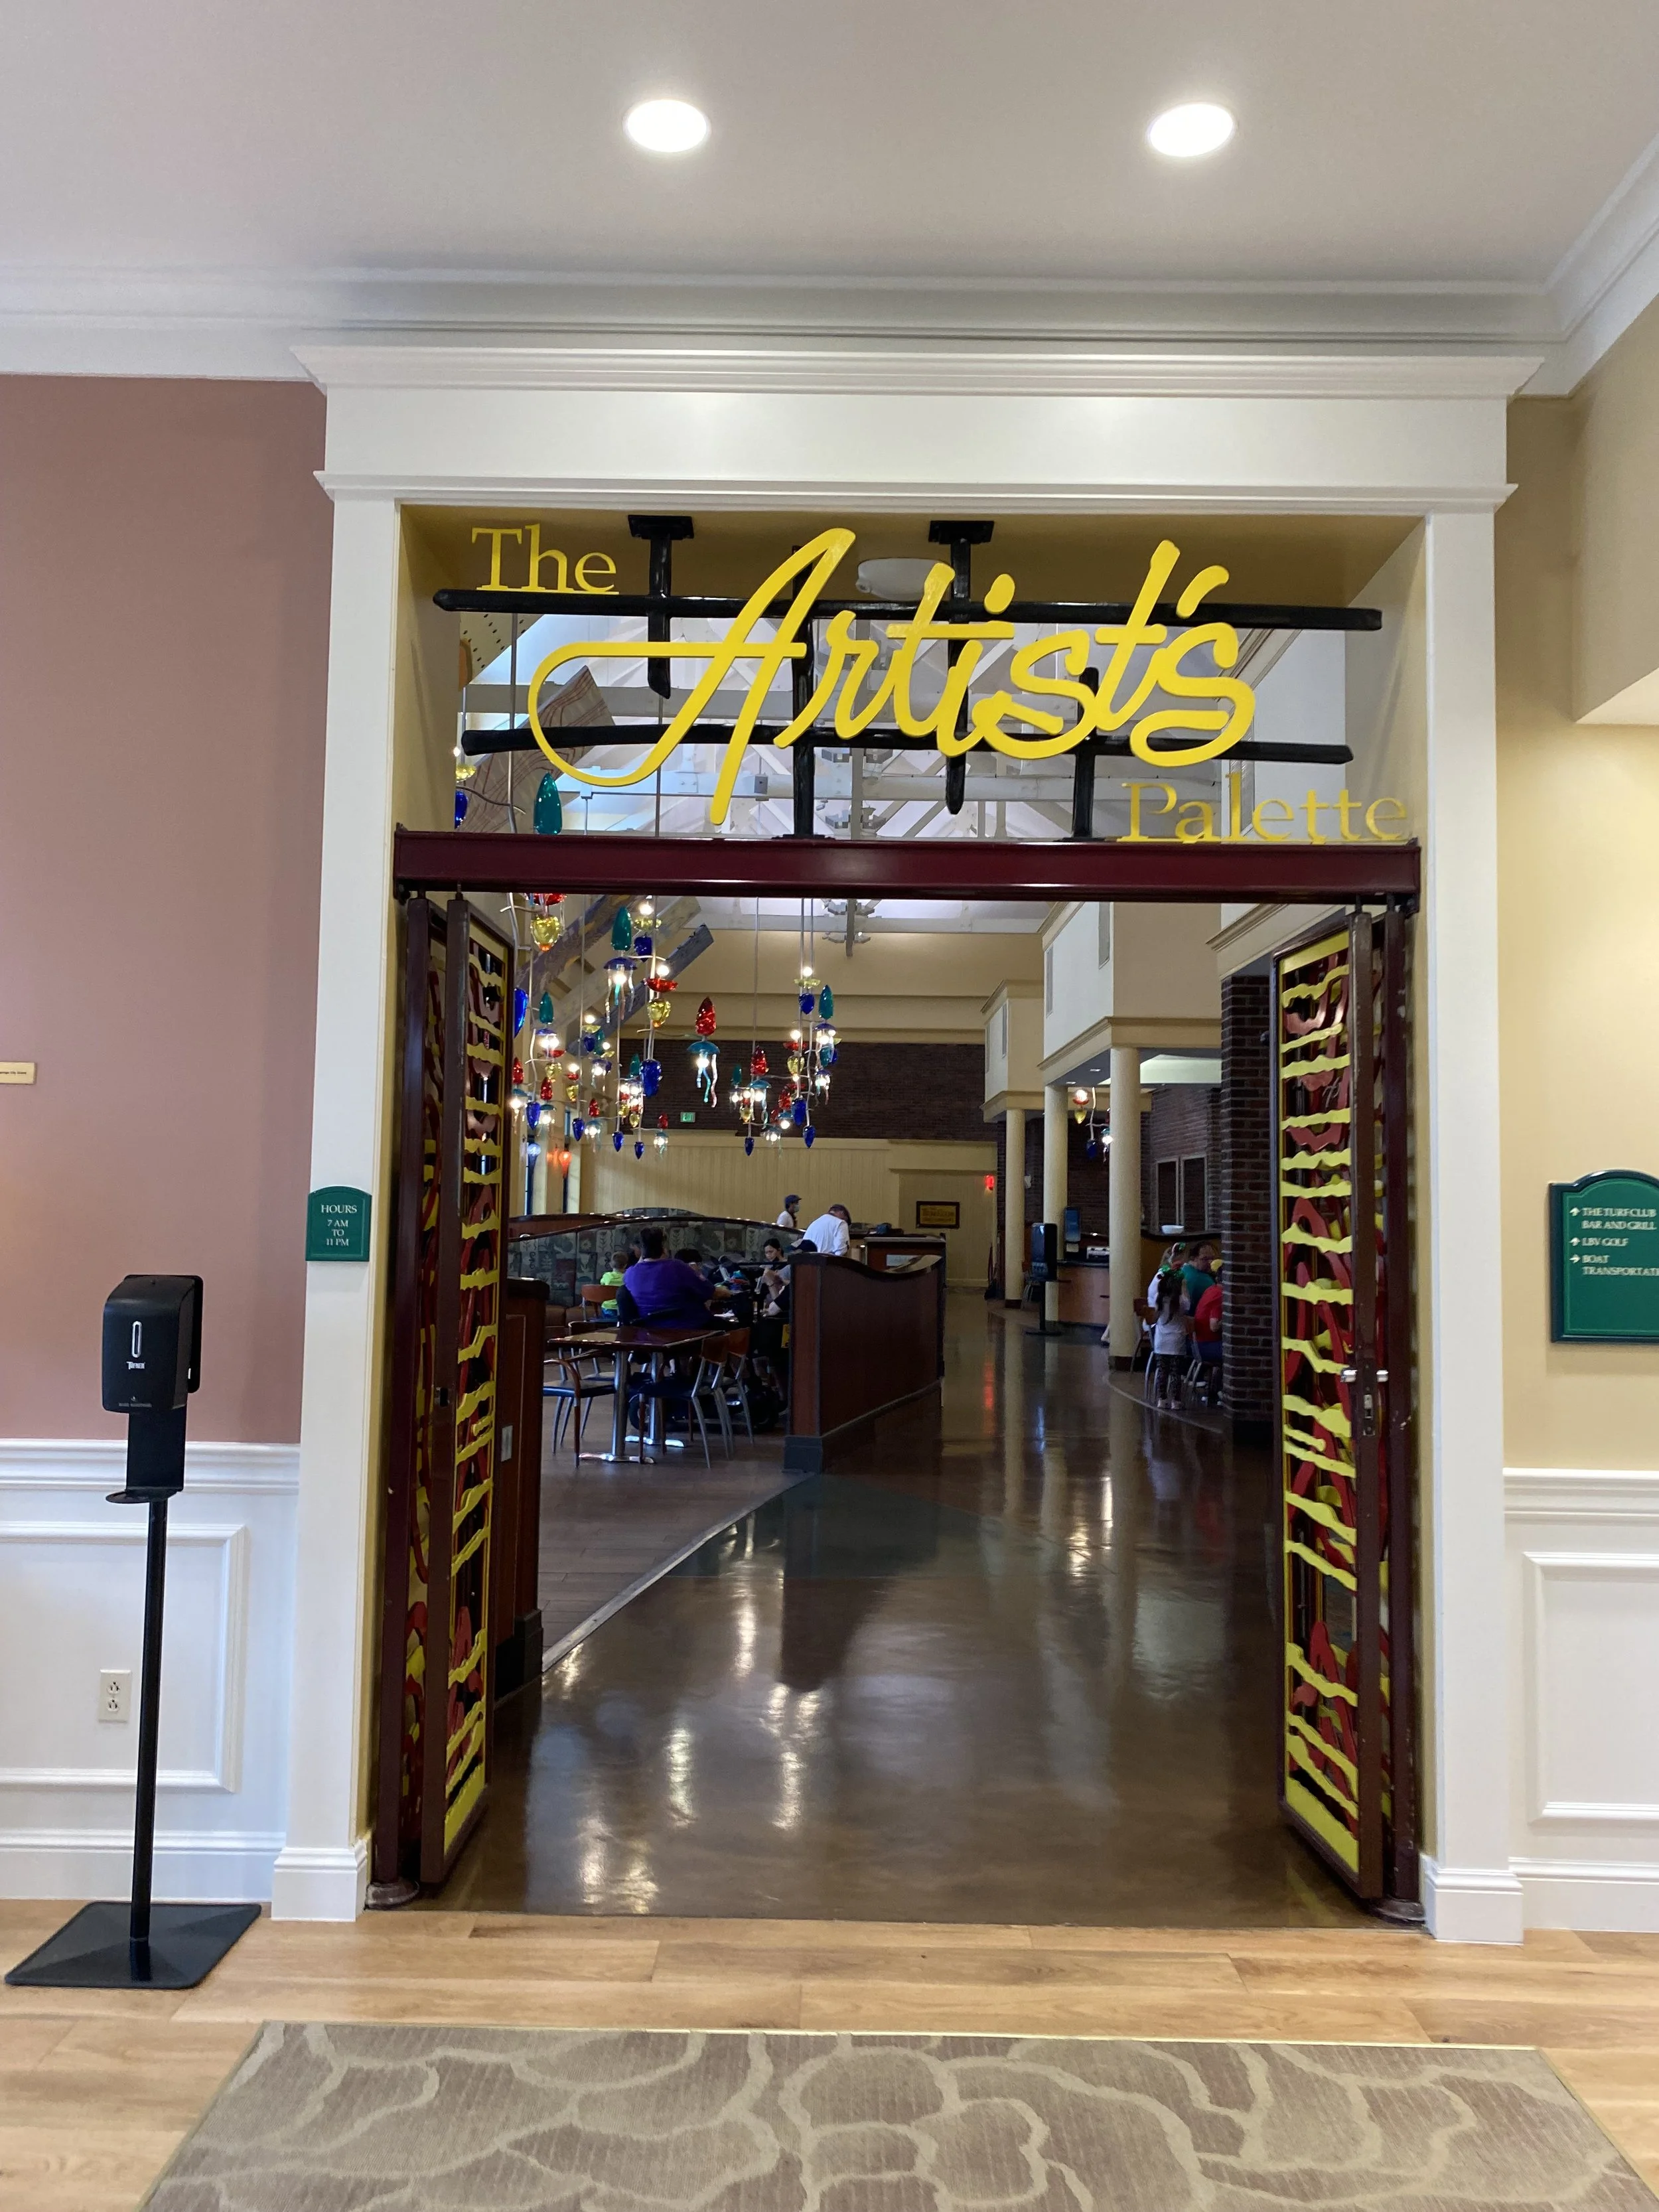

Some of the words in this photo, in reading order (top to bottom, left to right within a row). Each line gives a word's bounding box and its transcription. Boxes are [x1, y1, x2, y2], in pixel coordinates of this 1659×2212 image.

[472, 523, 618, 595] The
[528, 528, 1256, 826] Artist's
[1117, 772, 1407, 845] Palette
[321, 1204, 358, 1214] HOURS
[1581, 1207, 1603, 1217] THE
[1630, 1208, 1657, 1218] CLUB
[1581, 1220, 1603, 1229] BAR
[1603, 1220, 1627, 1230] AND
[1627, 1221, 1658, 1230] GRILL
[326, 1238, 333, 1246] 11
[335, 1238, 349, 1246] PM
[1601, 1237, 1630, 1247] GOLF
[1582, 1254, 1611, 1264] BOAT
